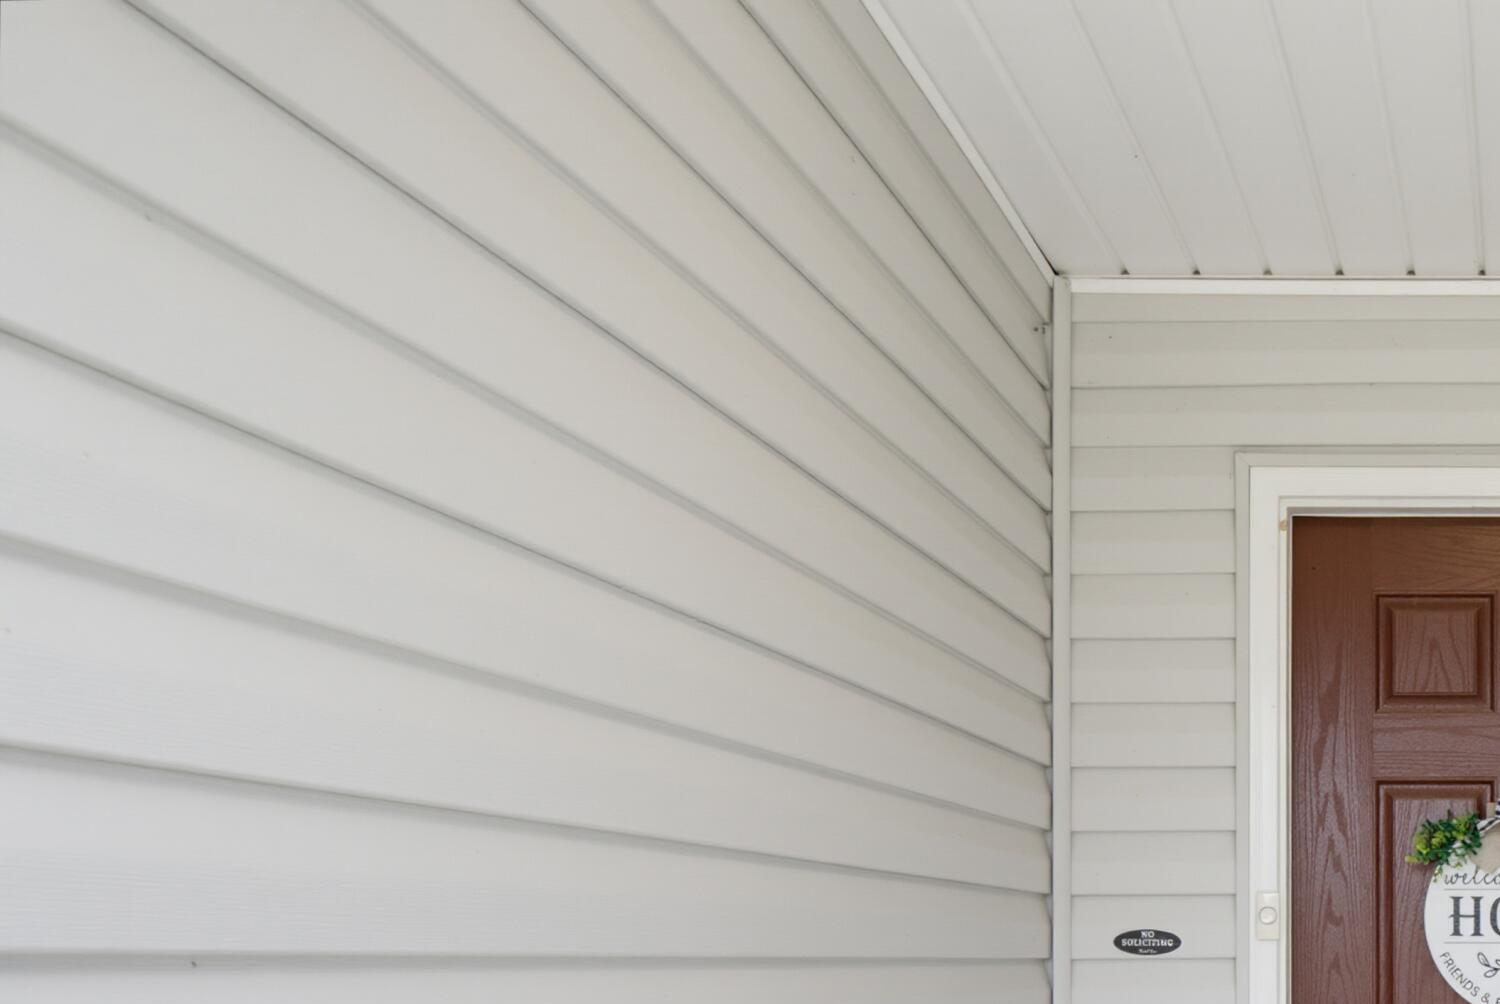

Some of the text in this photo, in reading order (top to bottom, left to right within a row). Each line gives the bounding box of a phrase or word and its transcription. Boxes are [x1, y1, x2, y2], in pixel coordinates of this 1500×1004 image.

[1140, 930, 1155, 938] NO
[1440, 952, 1481, 997] FRIENDS
[1480, 992, 1491, 1004] &
